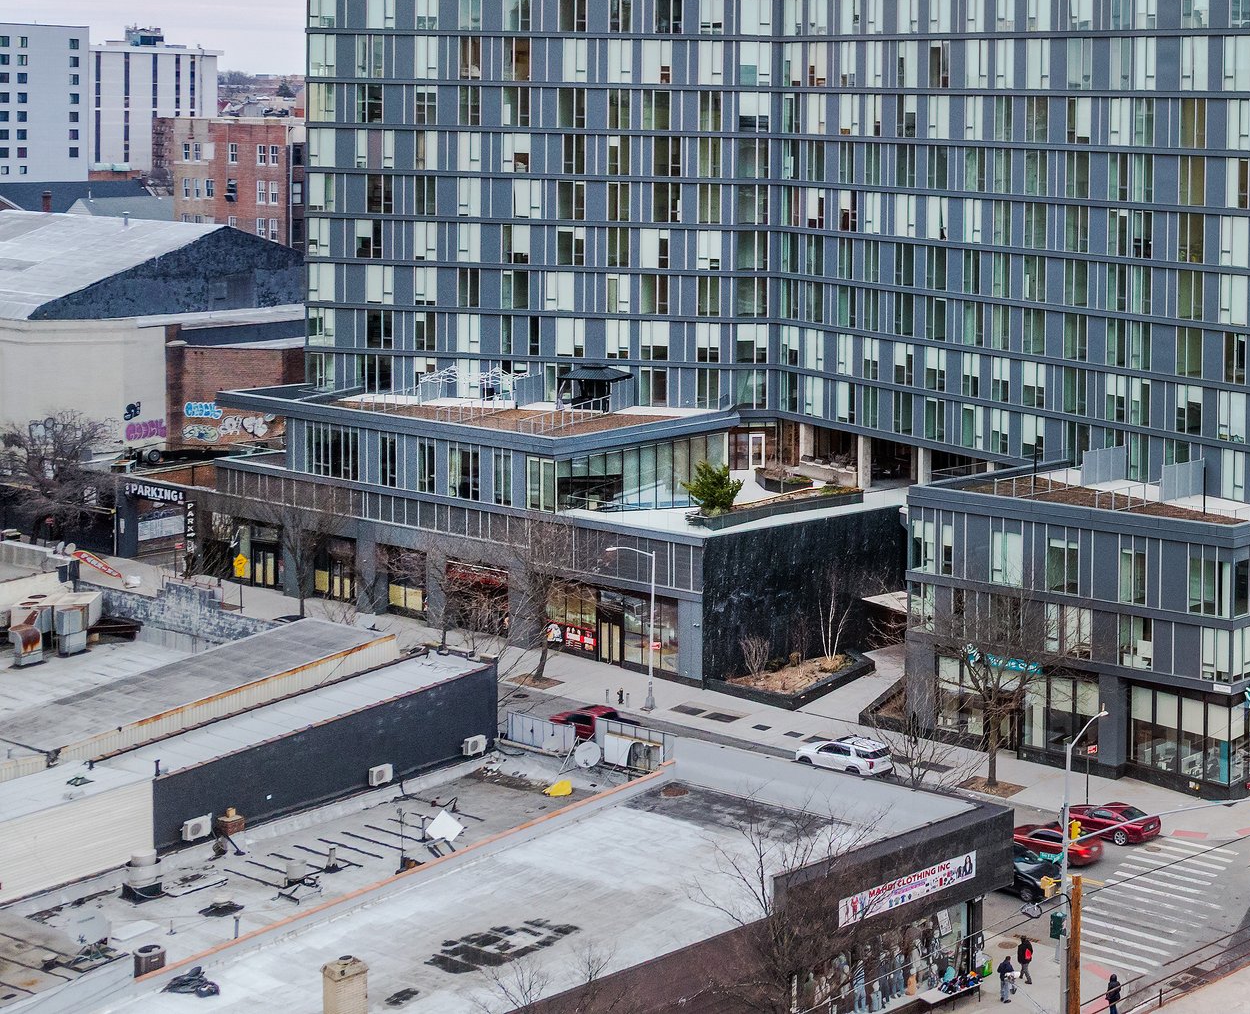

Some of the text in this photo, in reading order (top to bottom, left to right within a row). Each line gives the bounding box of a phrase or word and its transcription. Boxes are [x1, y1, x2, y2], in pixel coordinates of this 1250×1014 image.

[131, 483, 178, 501] PARKING
[897, 867, 936, 888] CLOTHING
[937, 862, 951, 873] INC
